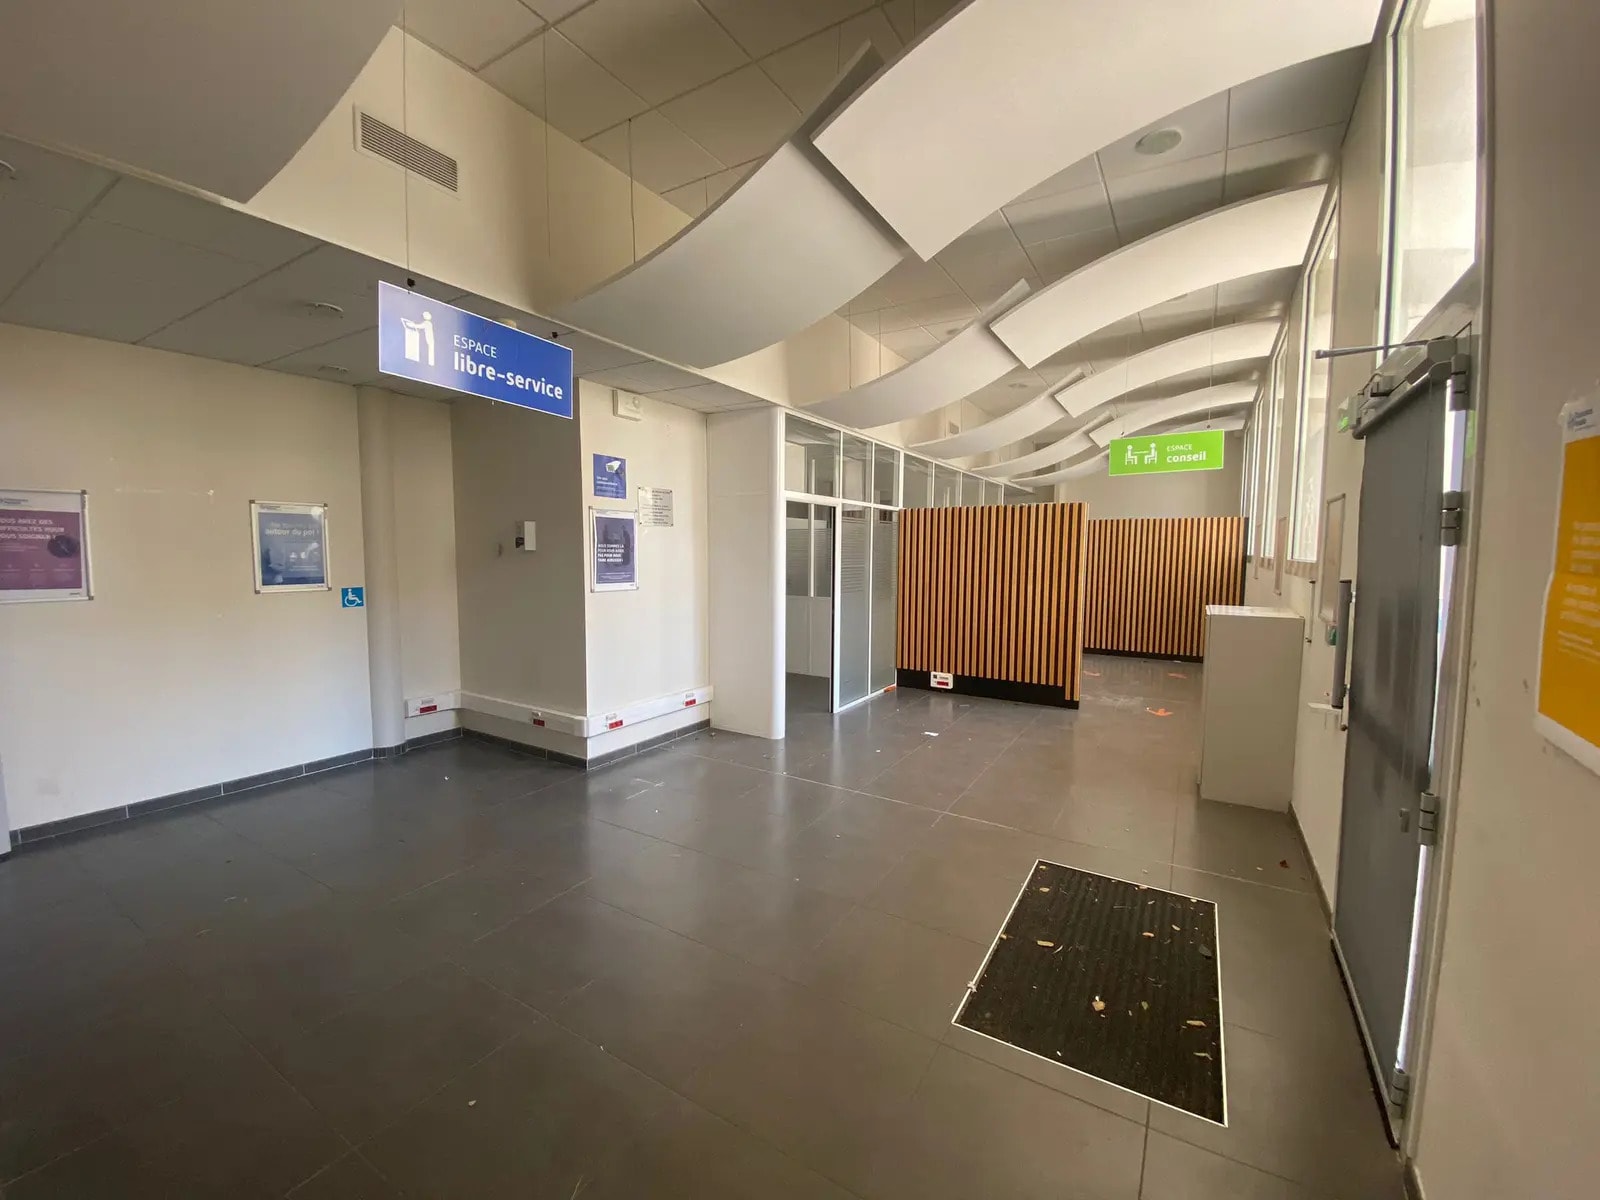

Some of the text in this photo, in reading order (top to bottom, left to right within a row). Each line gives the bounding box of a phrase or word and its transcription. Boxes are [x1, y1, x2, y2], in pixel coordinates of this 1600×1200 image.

[453, 334, 497, 359] ESPACE
[453, 351, 563, 400] libre-service
[1166, 451, 1207, 463] conseil
[292, 527, 301, 535] du
